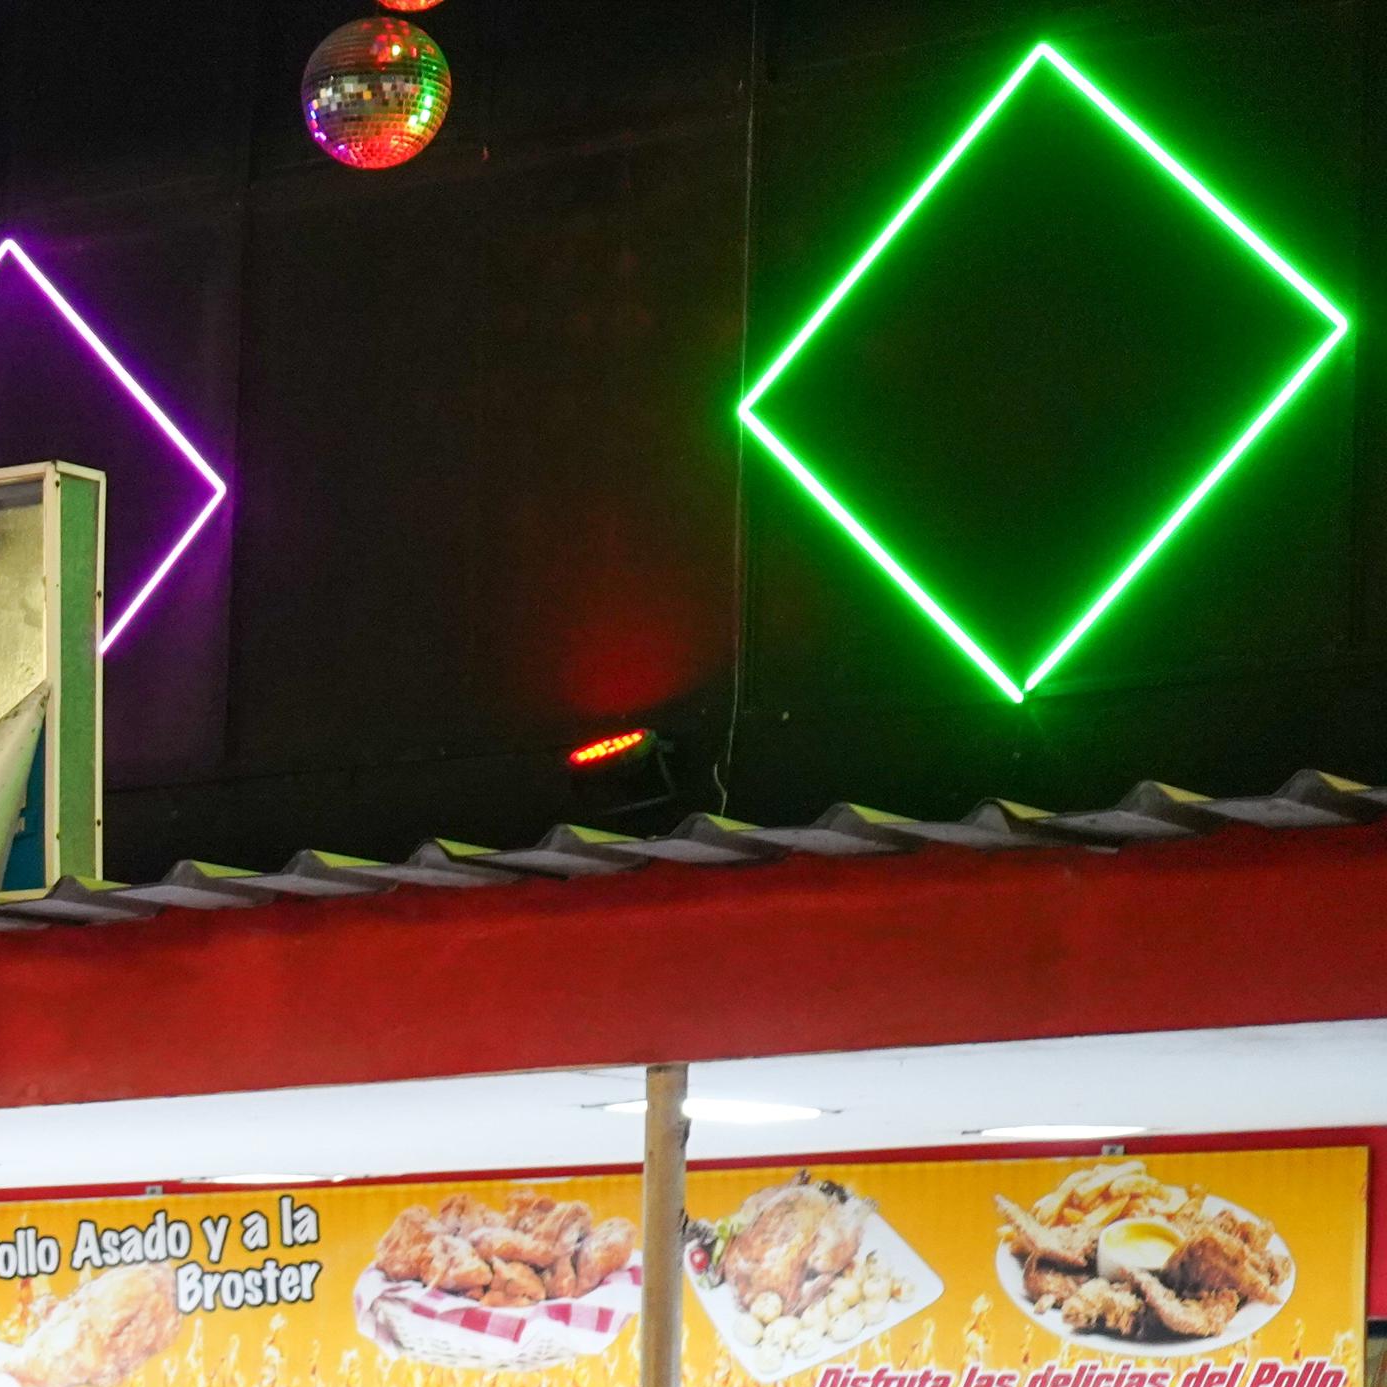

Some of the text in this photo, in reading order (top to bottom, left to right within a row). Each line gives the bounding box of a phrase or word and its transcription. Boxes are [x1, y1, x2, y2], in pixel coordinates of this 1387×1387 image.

[73, 1211, 190, 1270] Asado
[204, 1216, 228, 1262] y
[241, 1212, 269, 1250] a
[280, 1196, 319, 1246] la
[176, 1260, 320, 1314] Broster
